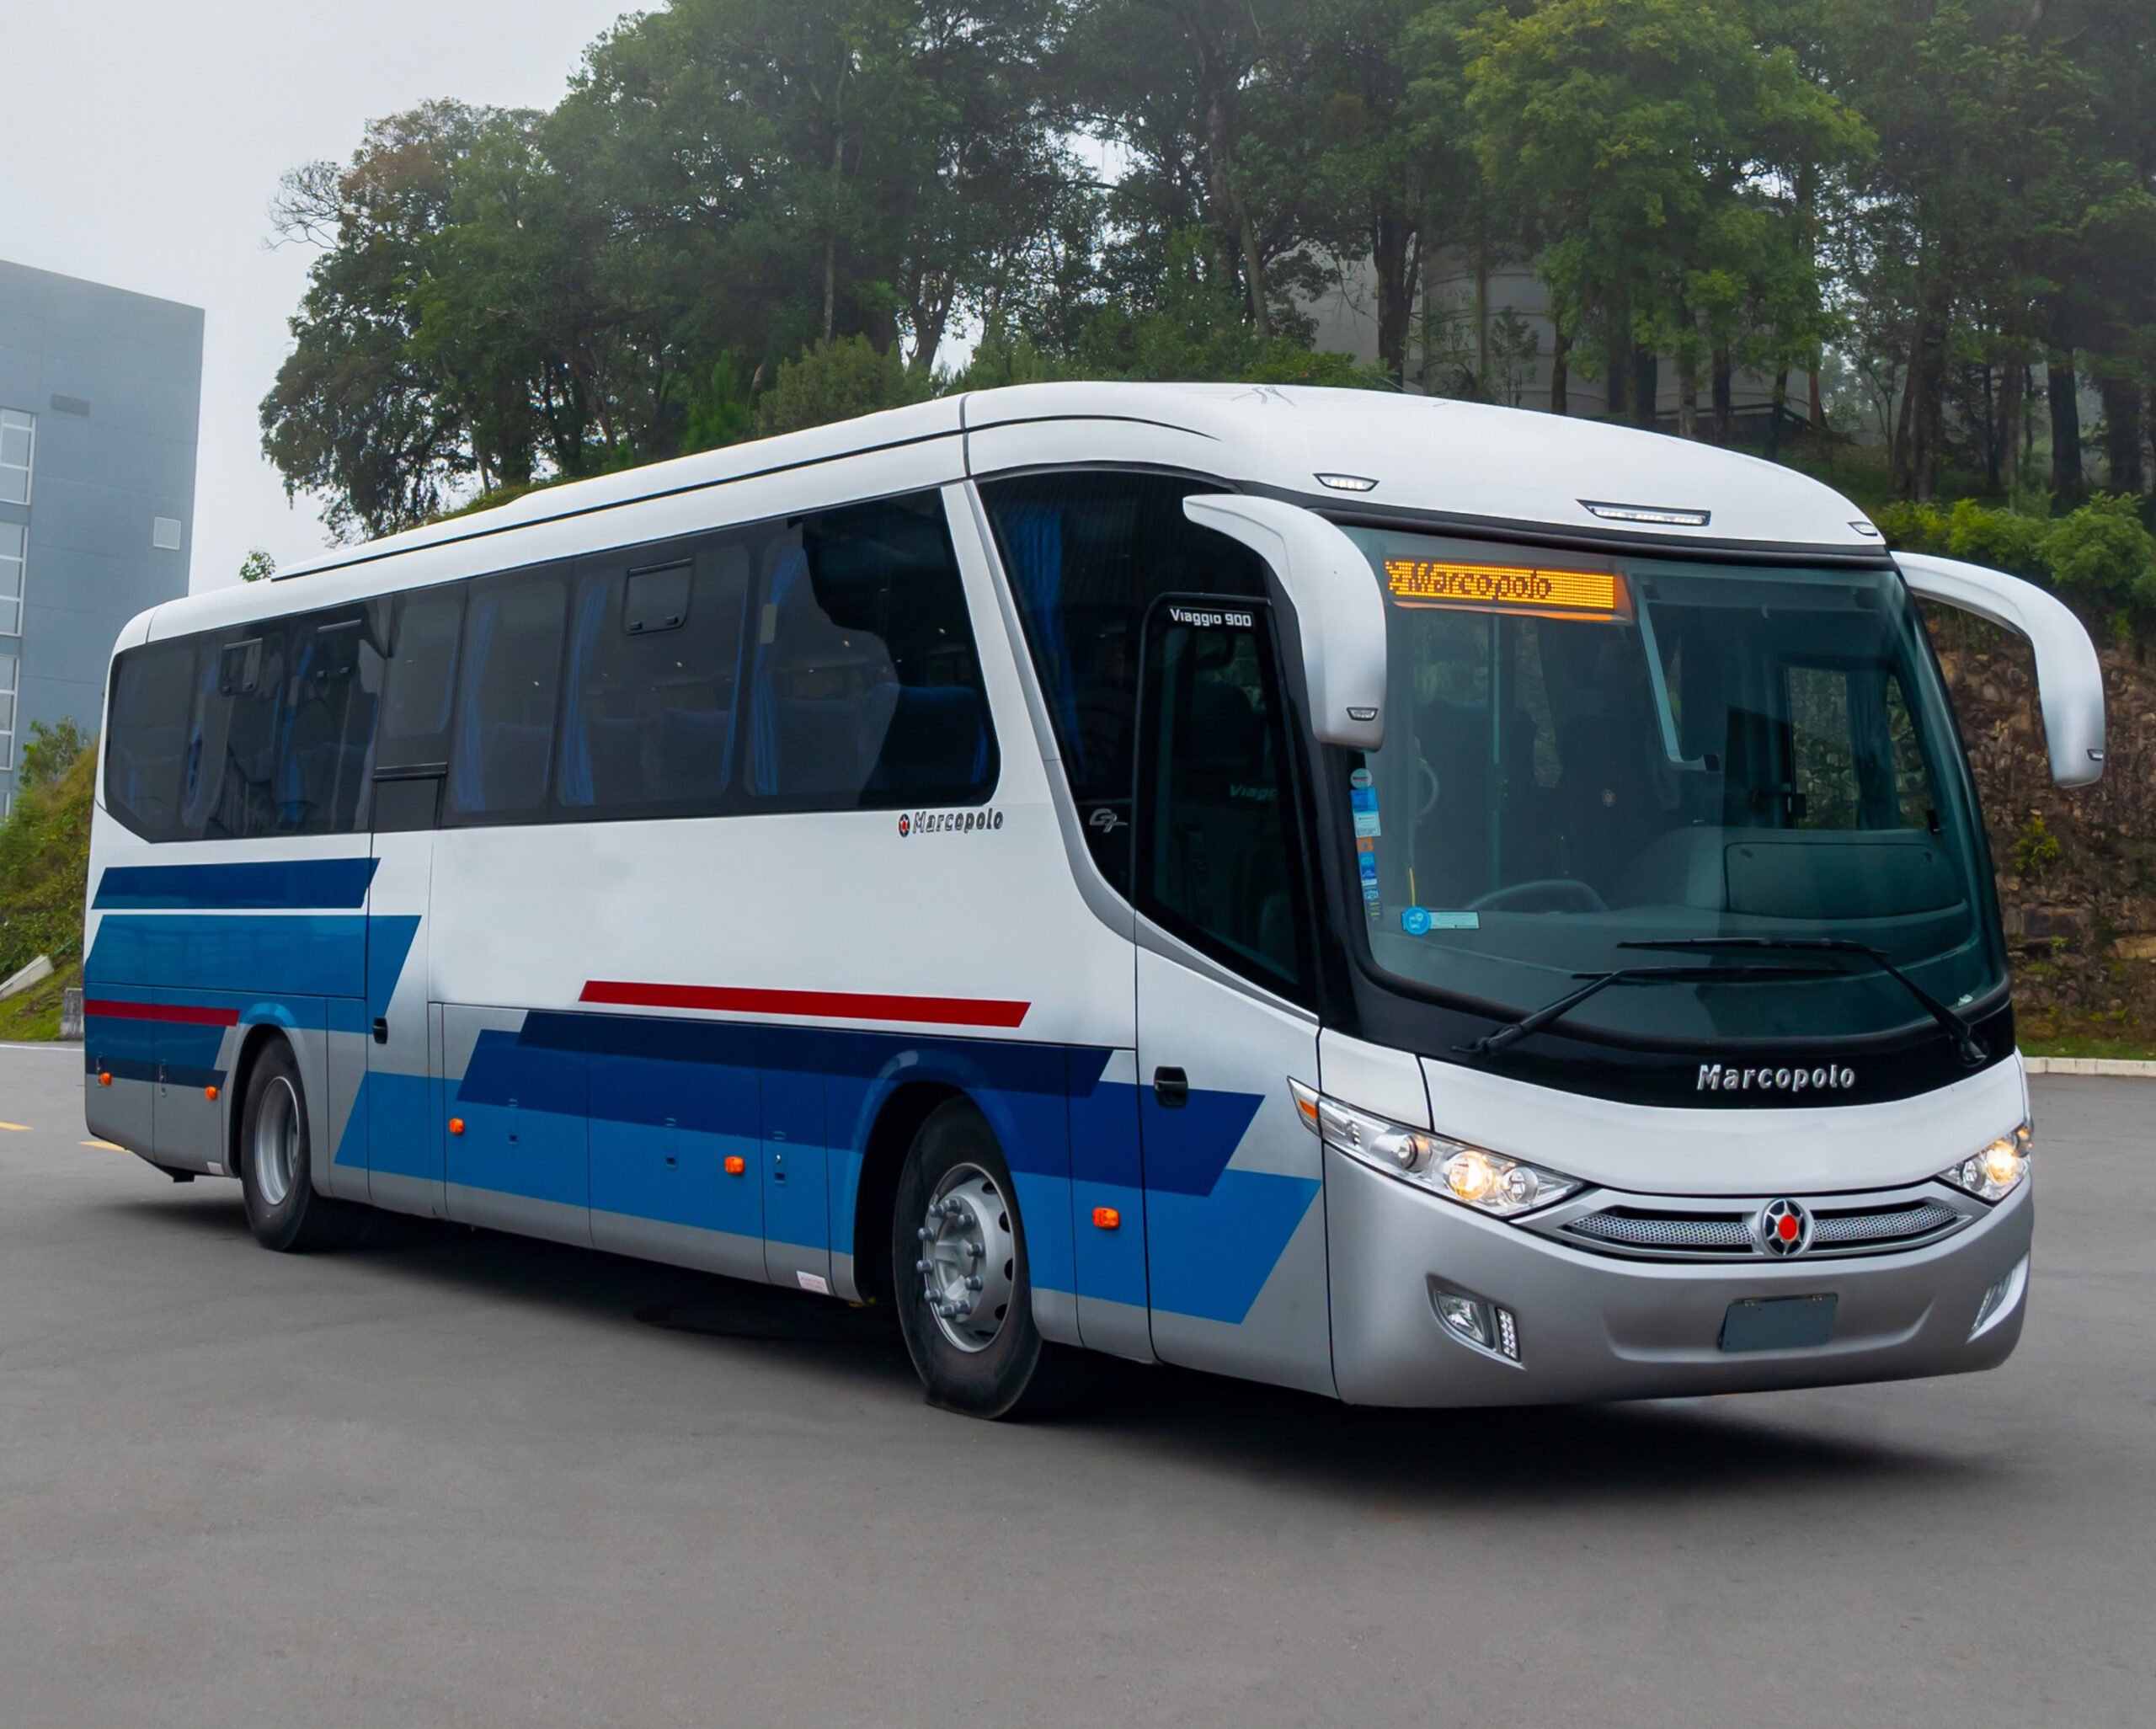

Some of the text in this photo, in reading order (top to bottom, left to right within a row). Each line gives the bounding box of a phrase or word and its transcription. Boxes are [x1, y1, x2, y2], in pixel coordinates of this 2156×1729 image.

[1406, 562, 1553, 600] Marcopolo
[1169, 608, 1252, 627] Viaggio 900
[913, 808, 1003, 834] Marcopolo
[1697, 1064, 1855, 1092] Marcopolo
